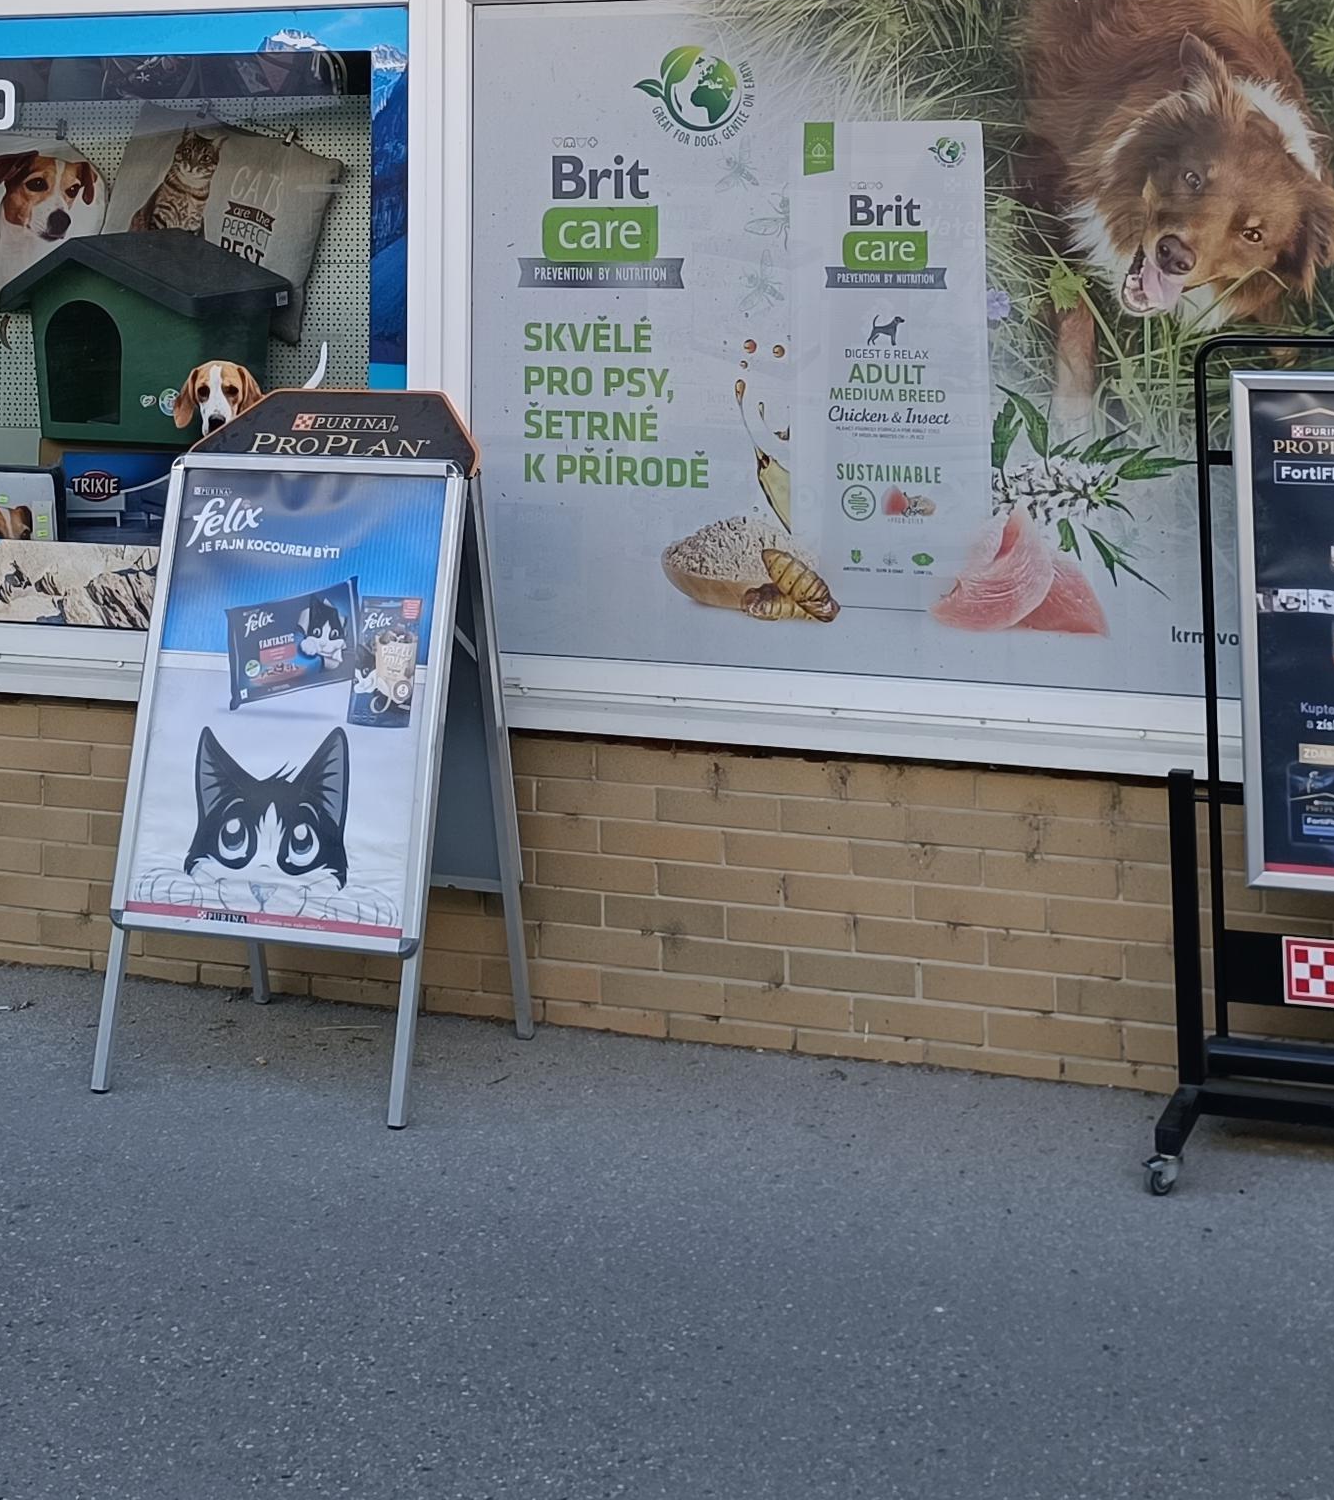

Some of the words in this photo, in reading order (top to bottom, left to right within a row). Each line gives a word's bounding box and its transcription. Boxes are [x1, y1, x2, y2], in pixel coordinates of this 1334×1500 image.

[737, 60, 755, 89] EARTH
[743, 93, 755, 108] ON
[652, 106, 674, 133] GREAT
[721, 110, 750, 140] GENTLE
[673, 129, 691, 145] FOR
[552, 154, 650, 200] Brit
[230, 165, 285, 214] CATS
[233, 207, 251, 218] are
[255, 210, 271, 227] the
[849, 194, 921, 227] Brit
[222, 217, 272, 252] PERFECT
[558, 219, 642, 249] care
[854, 239, 916, 262] care
[534, 266, 593, 282] PREVENTION
[598, 267, 610, 281] BY
[616, 267, 667, 282] NUTRITION
[837, 273, 880, 284] PREVENTION
[884, 273, 893, 284] BY
[896, 273, 934, 284] NUTRITION
[524, 315, 652, 353] SKVĚLÉ
[844, 349, 881, 359] DIGEST
[894, 349, 929, 360] RELAX
[524, 365, 593, 396] PRO
[603, 367, 674, 404] PSY,
[848, 363, 926, 385] ADULT
[829, 387, 894, 402] MEDIUM
[898, 389, 946, 404] BREED
[524, 401, 658, 442] ŠETRNÉ
[828, 405, 889, 424] Chicken
[891, 411, 902, 423] &
[904, 408, 951, 425] Insect
[1273, 439, 1314, 454] PRO
[524, 453, 546, 483] K
[556, 446, 709, 489] PŘÍRODĚ
[836, 463, 942, 484] SUSTAINABLE
[72, 477, 119, 494] TRIXIE
[185, 497, 263, 548] felix
[198, 541, 212, 553] JE
[215, 539, 245, 552] FAJN
[247, 539, 312, 558] KOCOUREM
[244, 611, 275, 638] felix
[362, 612, 393, 631] felix
[258, 633, 295, 649] FANTASTIC
[1171, 625, 1240, 646] krmvo
[1306, 720, 1314, 729] a
